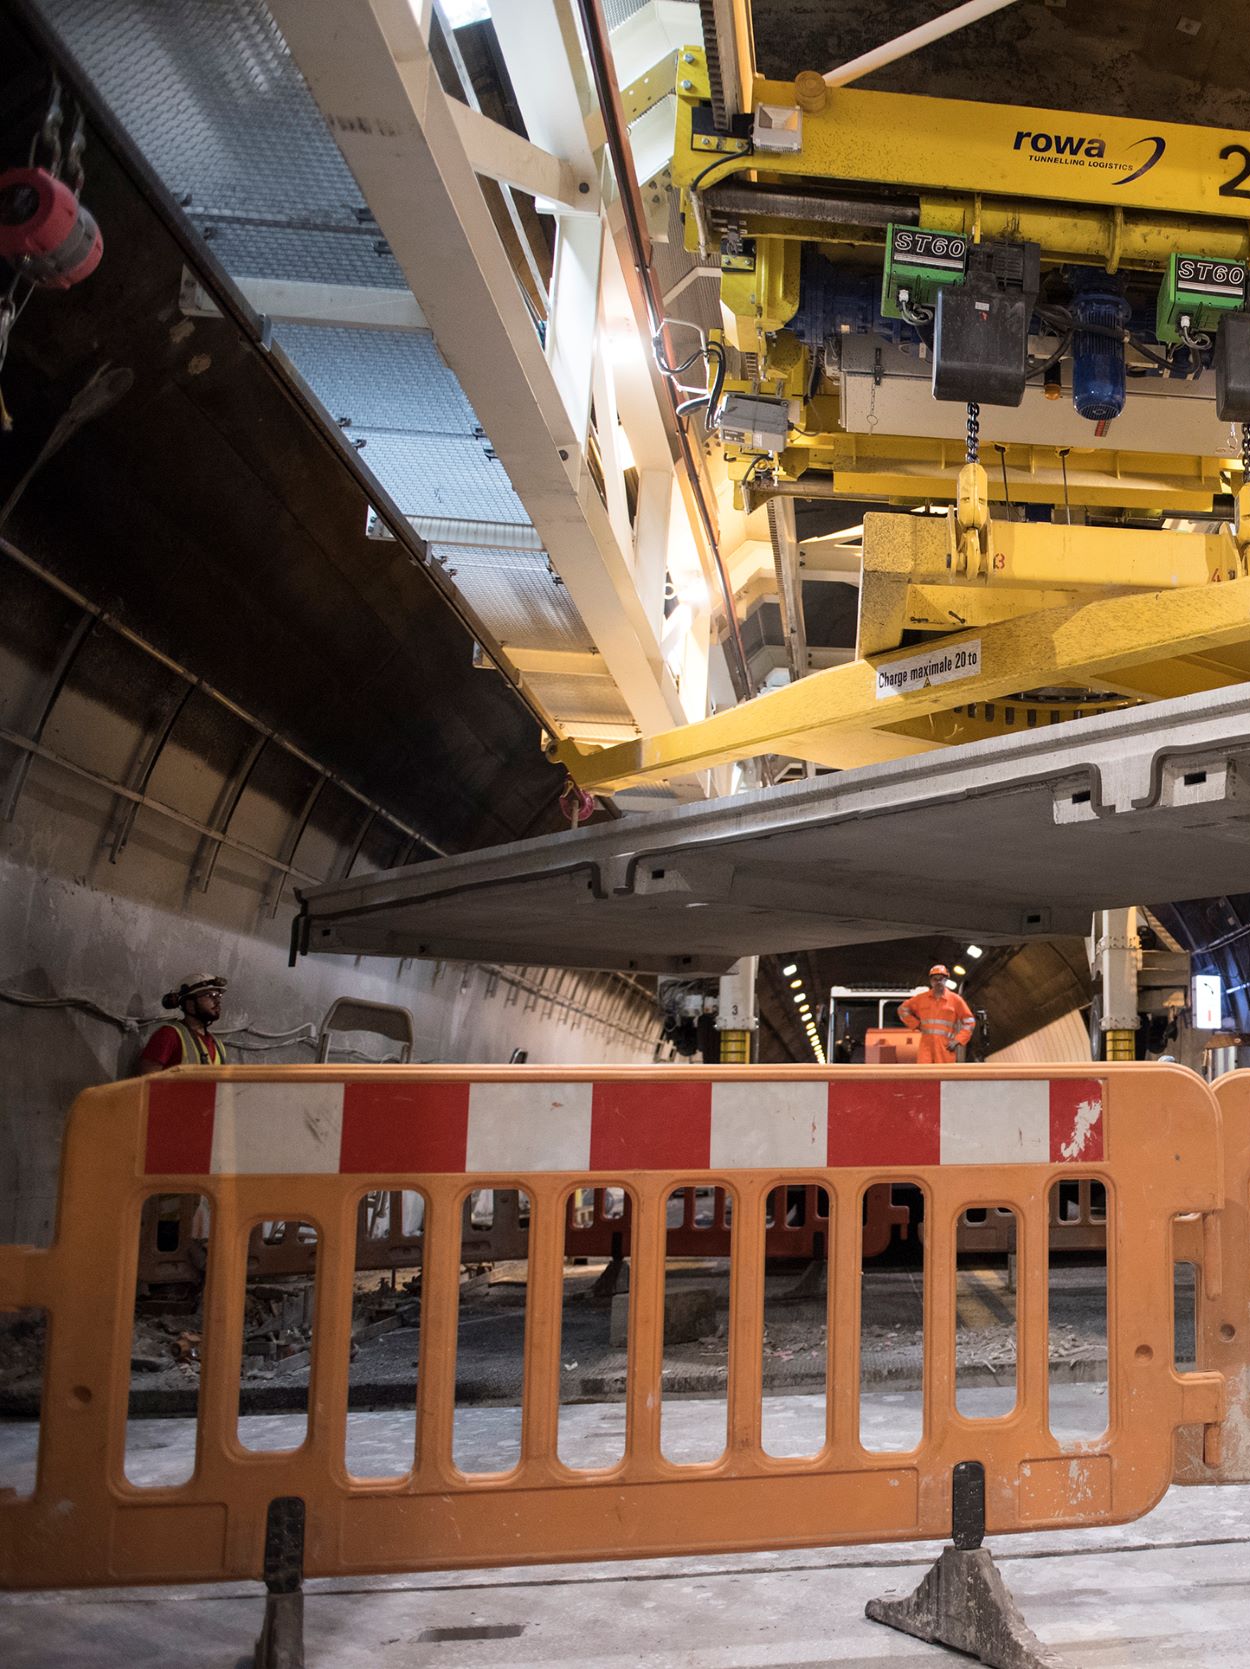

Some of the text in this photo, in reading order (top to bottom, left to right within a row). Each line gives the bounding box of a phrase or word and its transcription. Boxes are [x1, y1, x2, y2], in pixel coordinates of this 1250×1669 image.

[1013, 130, 1107, 159] rowa
[1028, 154, 1134, 171] TUNNELLING LOGISTICS
[894, 232, 965, 257] ST60
[1178, 260, 1245, 285] ST60
[878, 651, 978, 688] Charge maximale 20 to
[731, 1004, 739, 1016] 3
